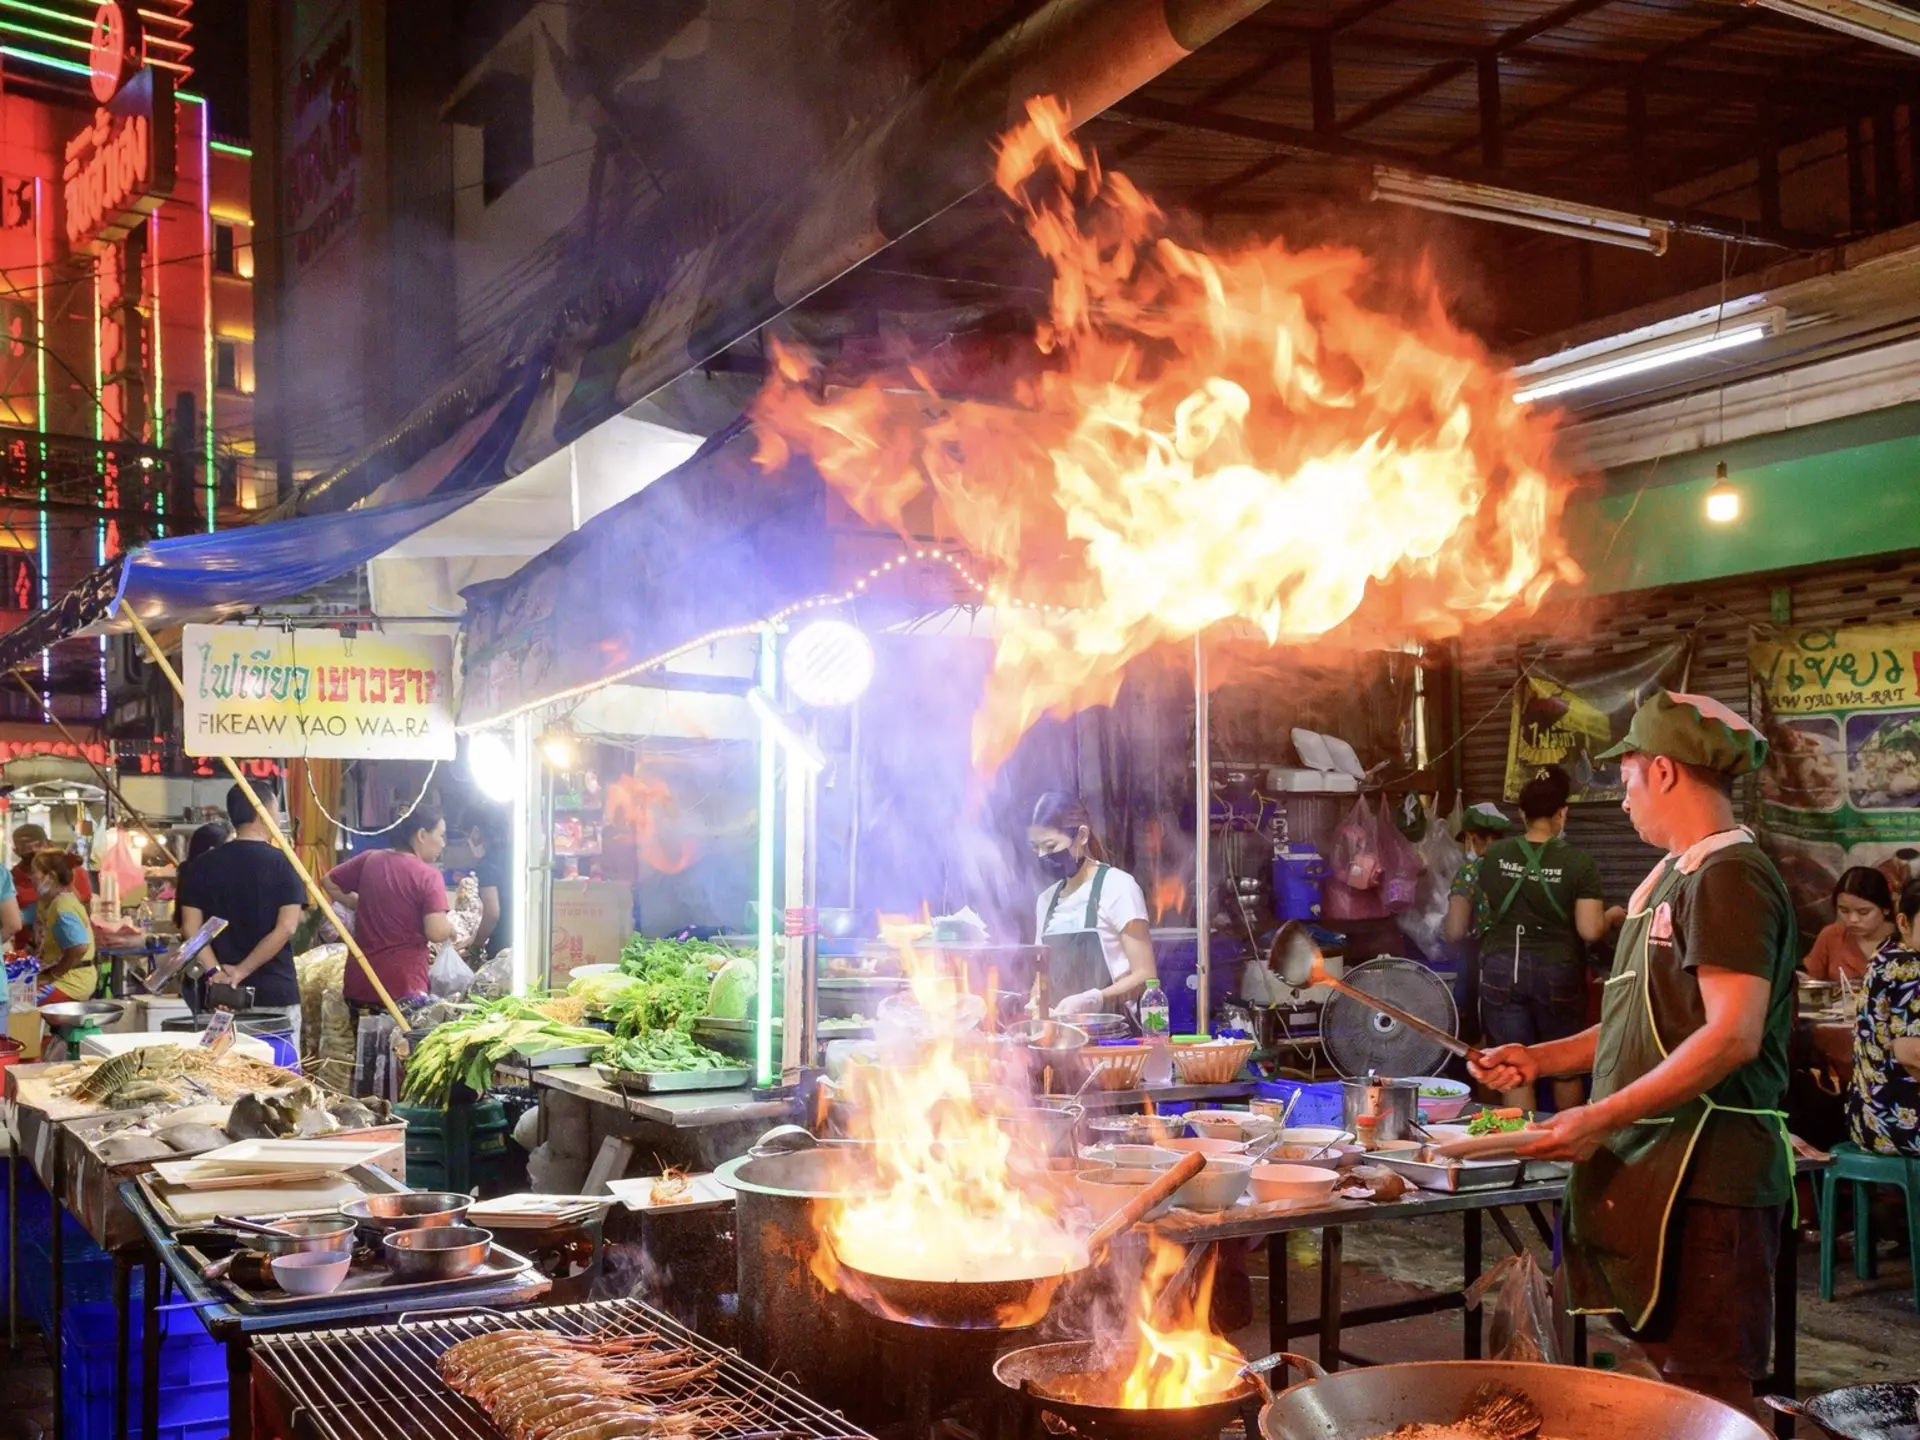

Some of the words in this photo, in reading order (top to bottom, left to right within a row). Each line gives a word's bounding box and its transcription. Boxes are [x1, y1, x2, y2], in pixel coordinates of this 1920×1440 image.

[197, 641, 311, 701] ไฟเขียว
[1804, 693, 1833, 710] YAO
[1836, 688, 1905, 705] WA-RAT
[198, 713, 286, 736] FIKEAW
[296, 715, 347, 737] YAO
[356, 717, 430, 738] WA-RA
